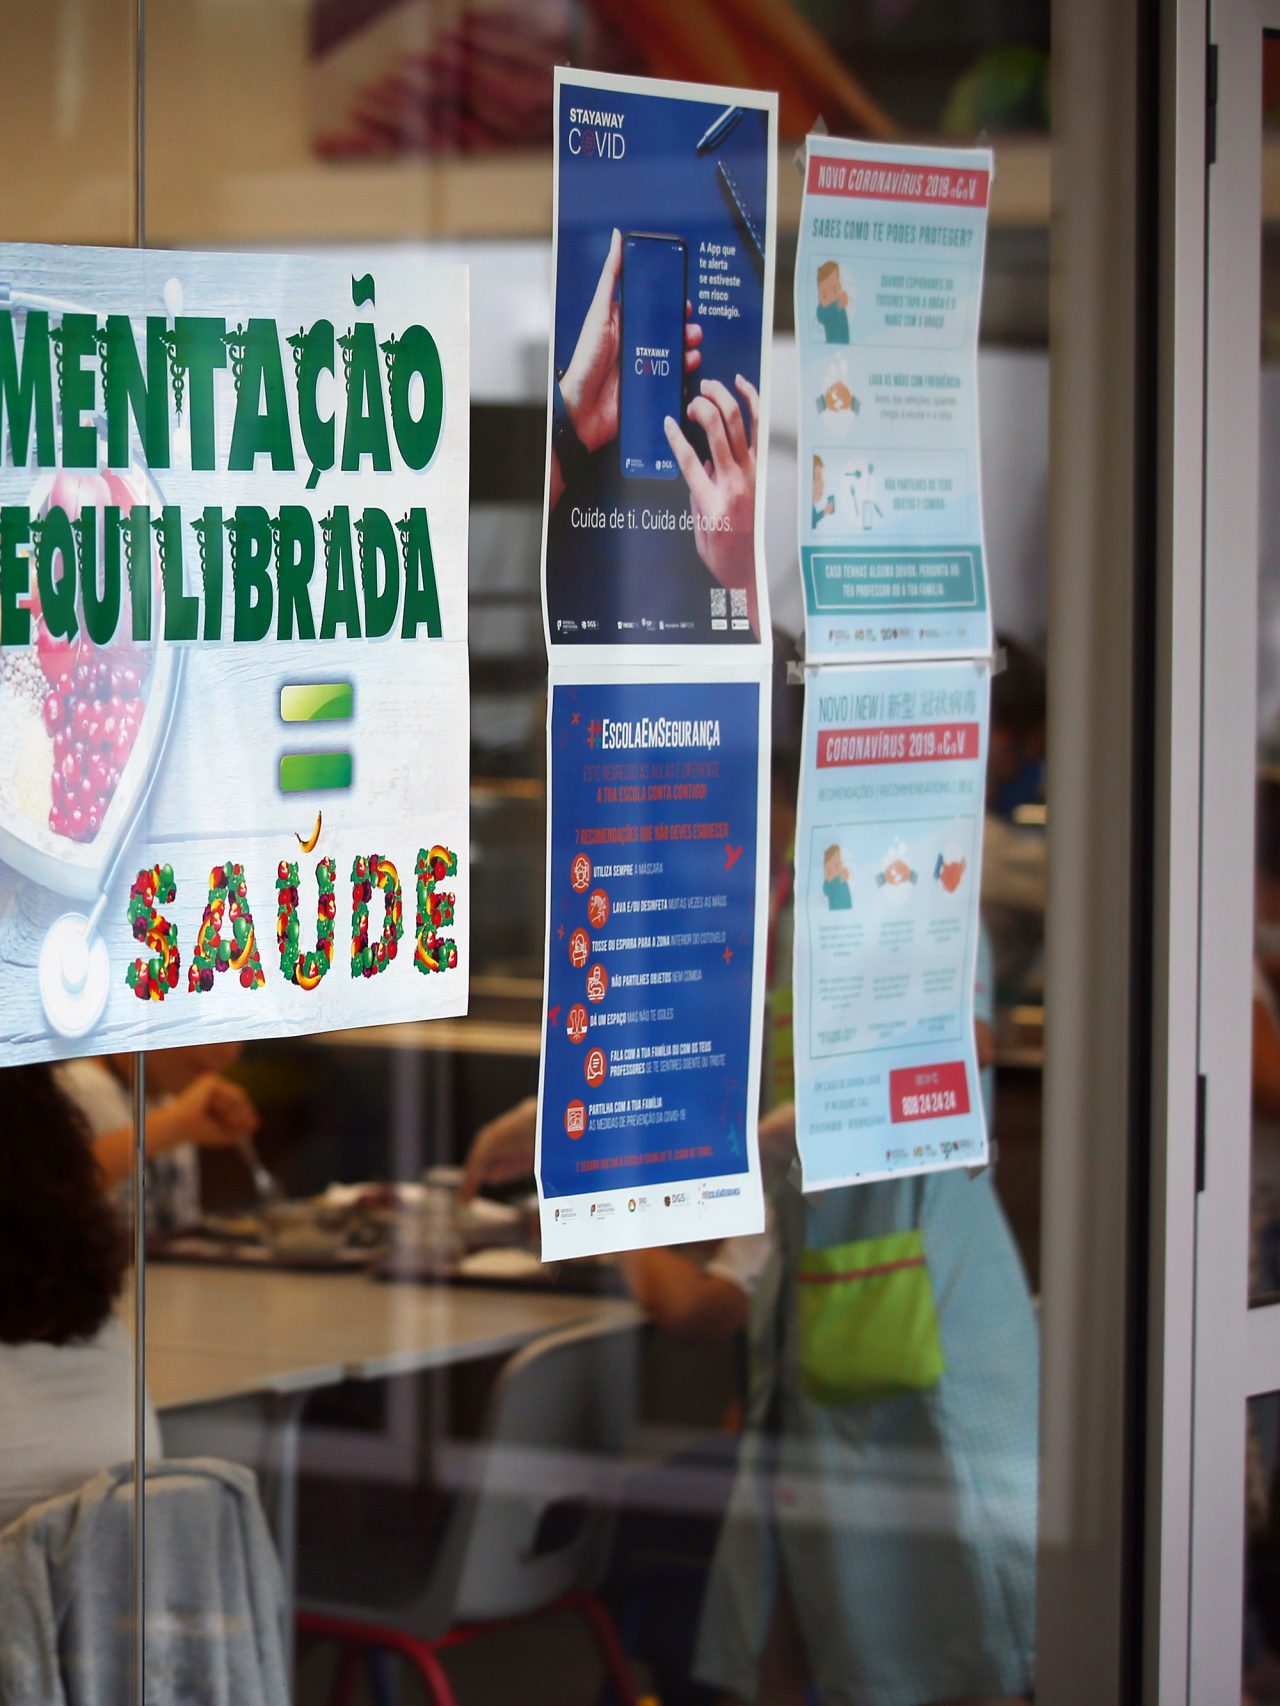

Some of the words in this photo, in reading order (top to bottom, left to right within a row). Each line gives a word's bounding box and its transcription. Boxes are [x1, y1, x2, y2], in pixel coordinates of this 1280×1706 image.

[570, 108, 624, 128] STAYAWAY
[569, 128, 625, 159] COVID
[818, 166, 847, 189] NOVO
[848, 168, 922, 195] CORONAVÍRUS
[812, 218, 840, 239] SABES
[844, 220, 868, 240] COMO
[872, 222, 883, 242] TE
[886, 223, 915, 244] PODES
[700, 242, 705, 253] A
[707, 242, 720, 256] App
[722, 246, 736, 257] que
[700, 258, 706, 269] te
[708, 258, 728, 270] alerta
[699, 275, 708, 284] se
[709, 274, 740, 287] estiveste
[699, 291, 710, 299] em
[711, 289, 728, 301] risco
[698, 304, 707, 315] de
[708, 305, 740, 320] contágio.
[636, 347, 670, 358] STAYAWAY
[571, 507, 606, 528] Cuida
[610, 508, 624, 528] de
[628, 509, 638, 529] ti.
[642, 509, 675, 530] Cuida
[678, 509, 694, 530] de
[697, 512, 733, 532] todos.
[818, 696, 848, 722] NOVO
[855, 694, 878, 720] NEW
[826, 730, 905, 762] CORONAVÍRUS
[594, 866, 612, 877] UTILIZA
[613, 864, 633, 876] SEMPRE
[126, 810, 460, 1002] SAÚDE
[613, 902, 627, 914] LAVA
[640, 899, 667, 912] DESINFETA
[592, 940, 607, 952] TOSSE
[608, 940, 615, 951] OU
[638, 937, 651, 949] PARA
[656, 936, 670, 947] ZONA
[611, 974, 621, 987] NÃO
[622, 972, 649, 986] PARTILHES
[598, 1014, 606, 1026] UM
[610, 1050, 623, 1061] FALA
[624, 1049, 635, 1060] COM
[610, 1063, 645, 1077] PROFESSORES
[589, 1101, 613, 1115] PARTILHA
[614, 1101, 625, 1112] COM
